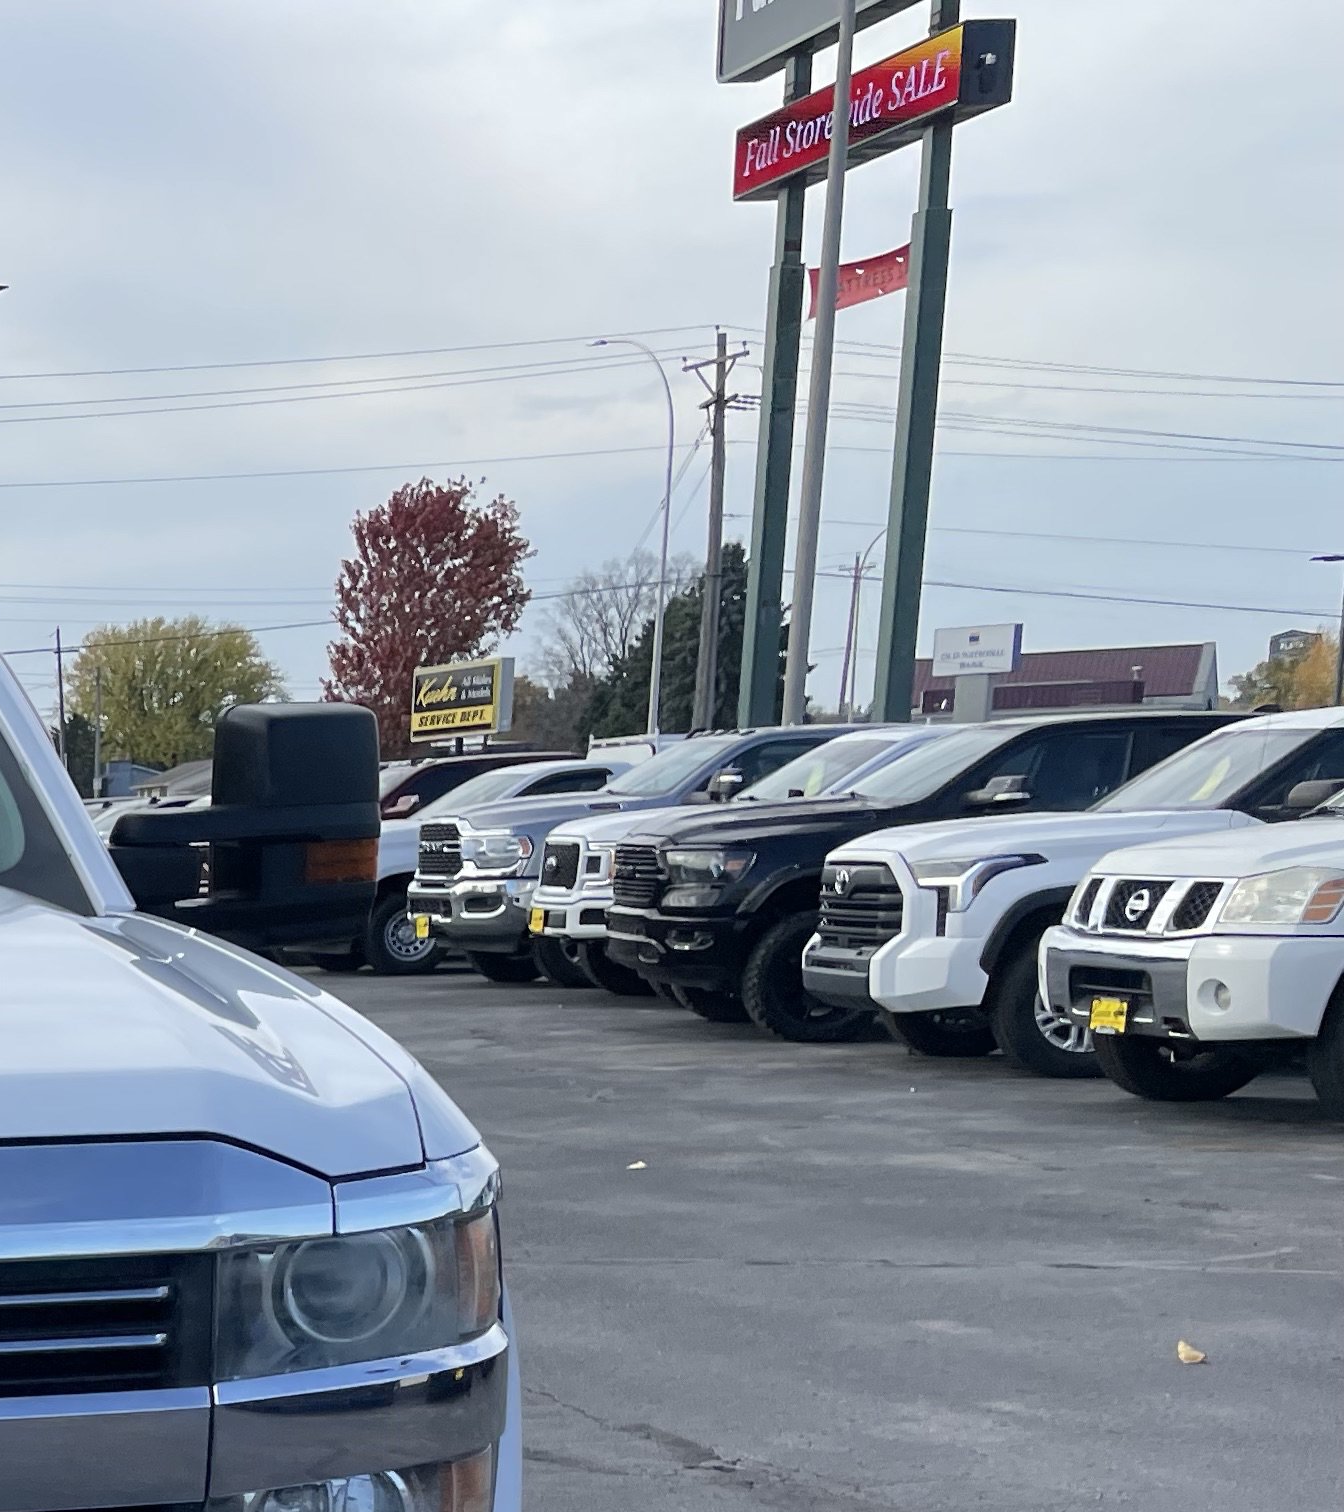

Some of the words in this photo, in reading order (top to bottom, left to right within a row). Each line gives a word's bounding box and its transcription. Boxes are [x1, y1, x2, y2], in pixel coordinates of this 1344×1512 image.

[743, 126, 781, 177] Fall
[783, 82, 883, 158] Storeide
[888, 48, 951, 111] SALE
[418, 711, 458, 728] SERVICE
